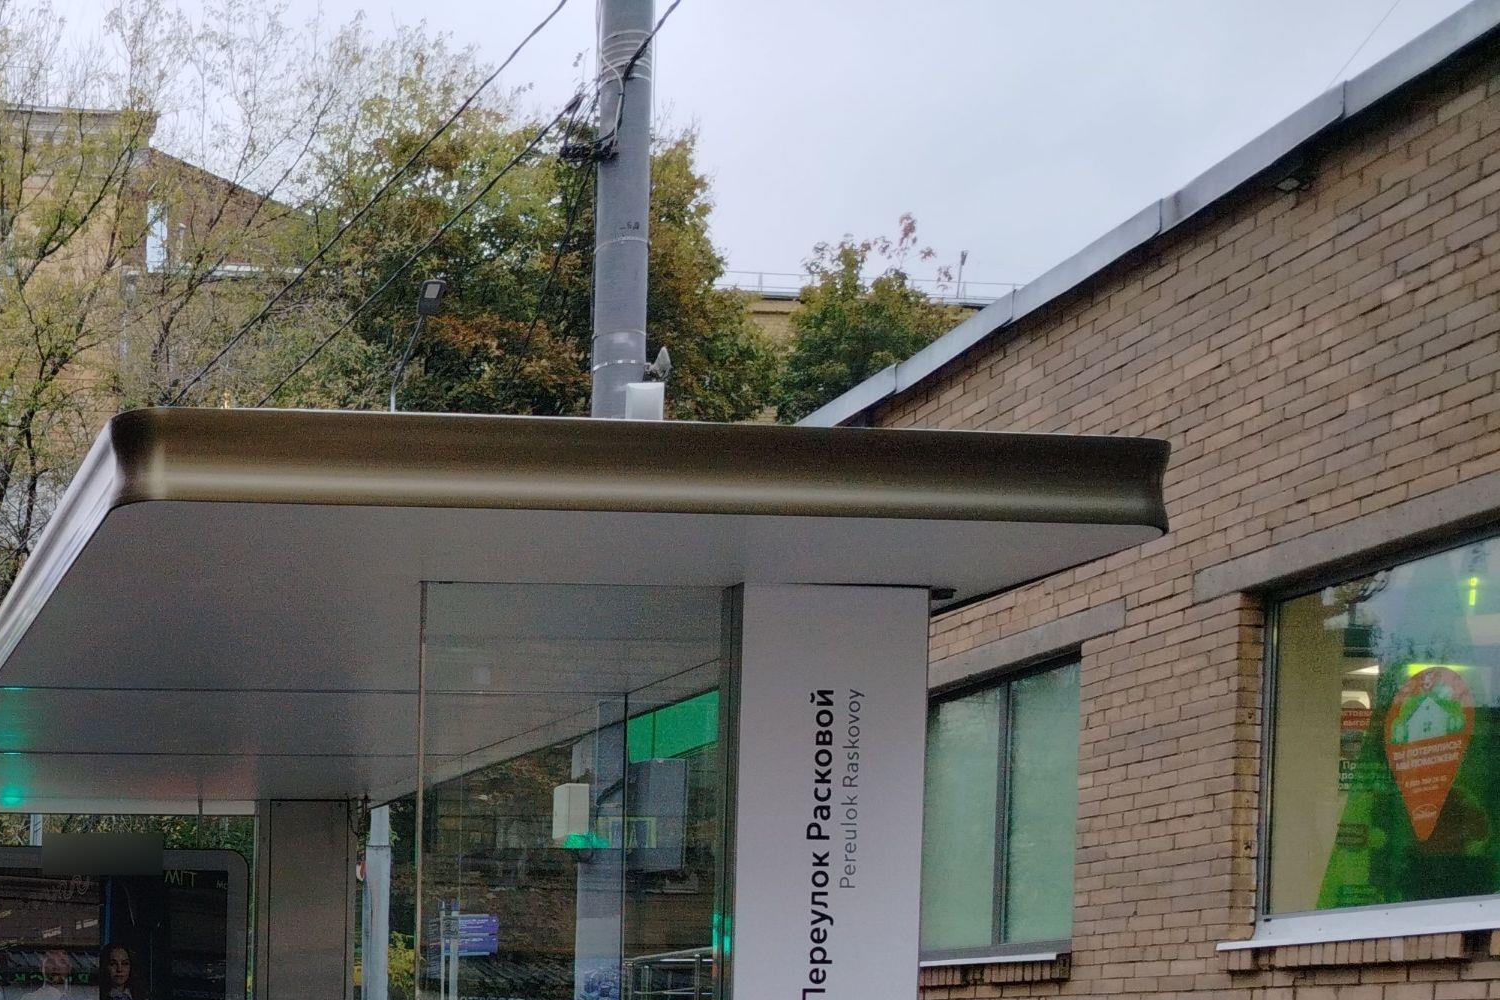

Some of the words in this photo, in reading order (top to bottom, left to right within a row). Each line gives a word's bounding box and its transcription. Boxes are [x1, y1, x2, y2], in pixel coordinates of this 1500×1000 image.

[806, 689, 835, 841] Расковой
[842, 688, 865, 788] Raskovoy
[839, 796, 860, 889] Pereulok
